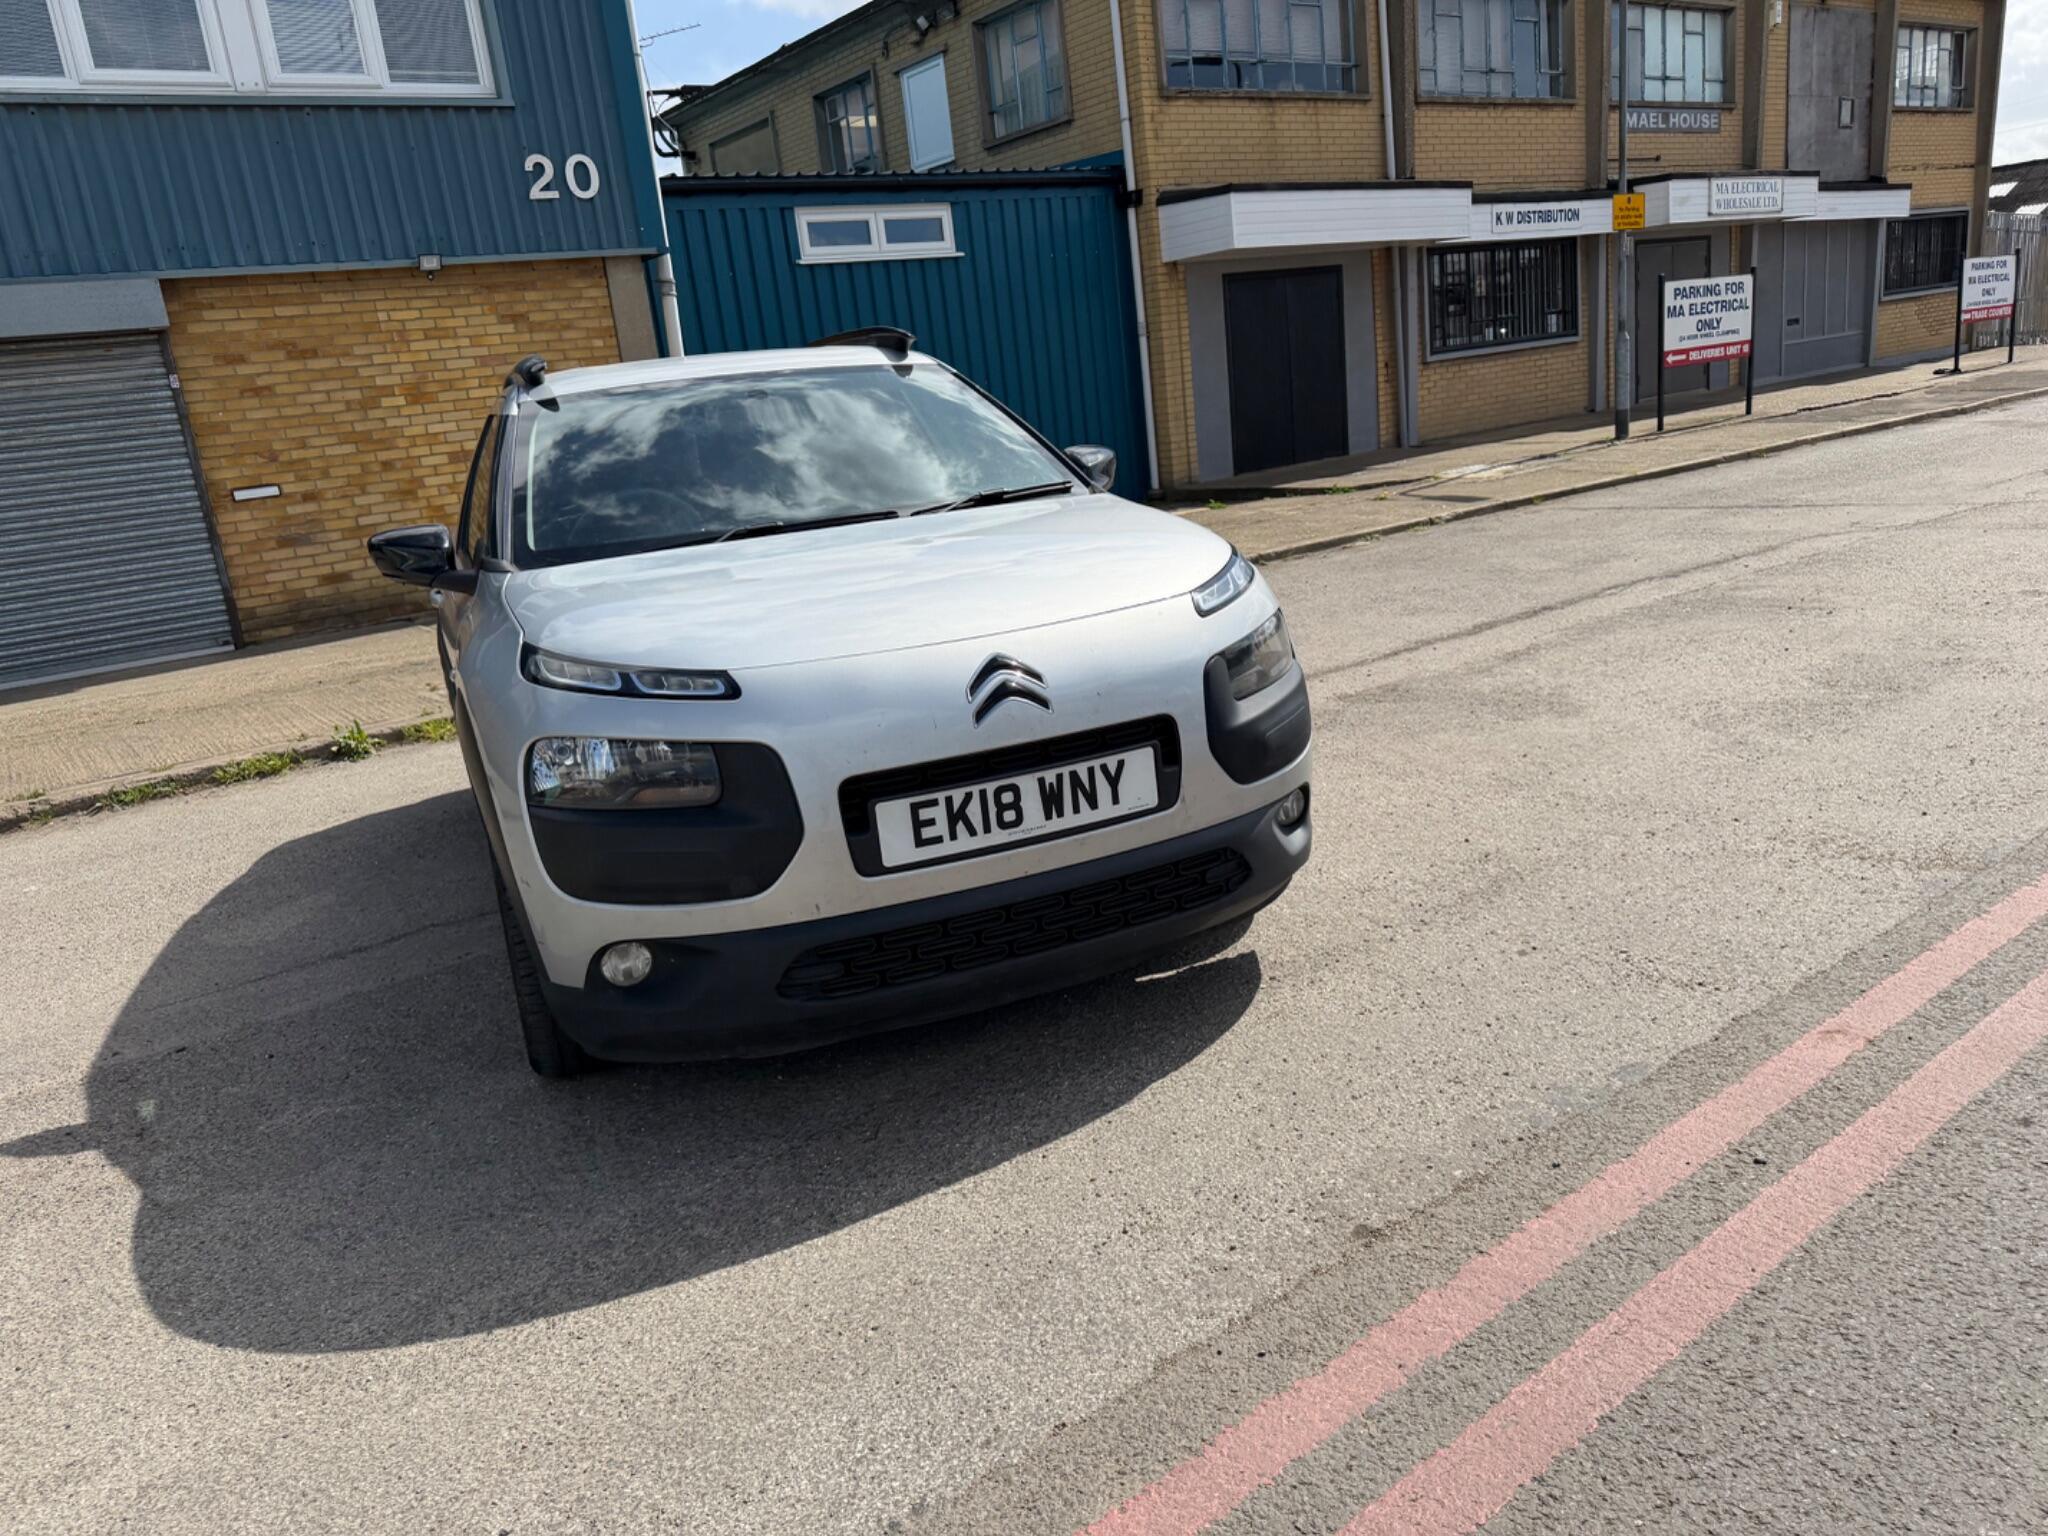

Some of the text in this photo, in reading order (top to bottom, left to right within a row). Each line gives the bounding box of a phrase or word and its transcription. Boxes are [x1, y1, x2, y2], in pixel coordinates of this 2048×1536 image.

[1669, 112, 1719, 129] HOUSE
[524, 153, 600, 200] 20
[1716, 181, 1779, 195] MA ELECTRICAL
[1715, 197, 1761, 210] WHOLESALE
[1495, 208, 1580, 225] K W DISTRIBUTION
[1971, 260, 2007, 271] PARKING FOR
[1978, 273, 2010, 284] ELECTRICAL
[1674, 282, 1744, 300] PARKING FOR
[1982, 288, 1996, 297] ONLY
[1667, 298, 1749, 318] MA ELECTRICAL
[1696, 317, 1723, 332] ONLY
[1689, 348, 1724, 360] DELIVERIES
[1727, 345, 1740, 355] UNIT
[909, 759, 1125, 848] EK18 WNY
